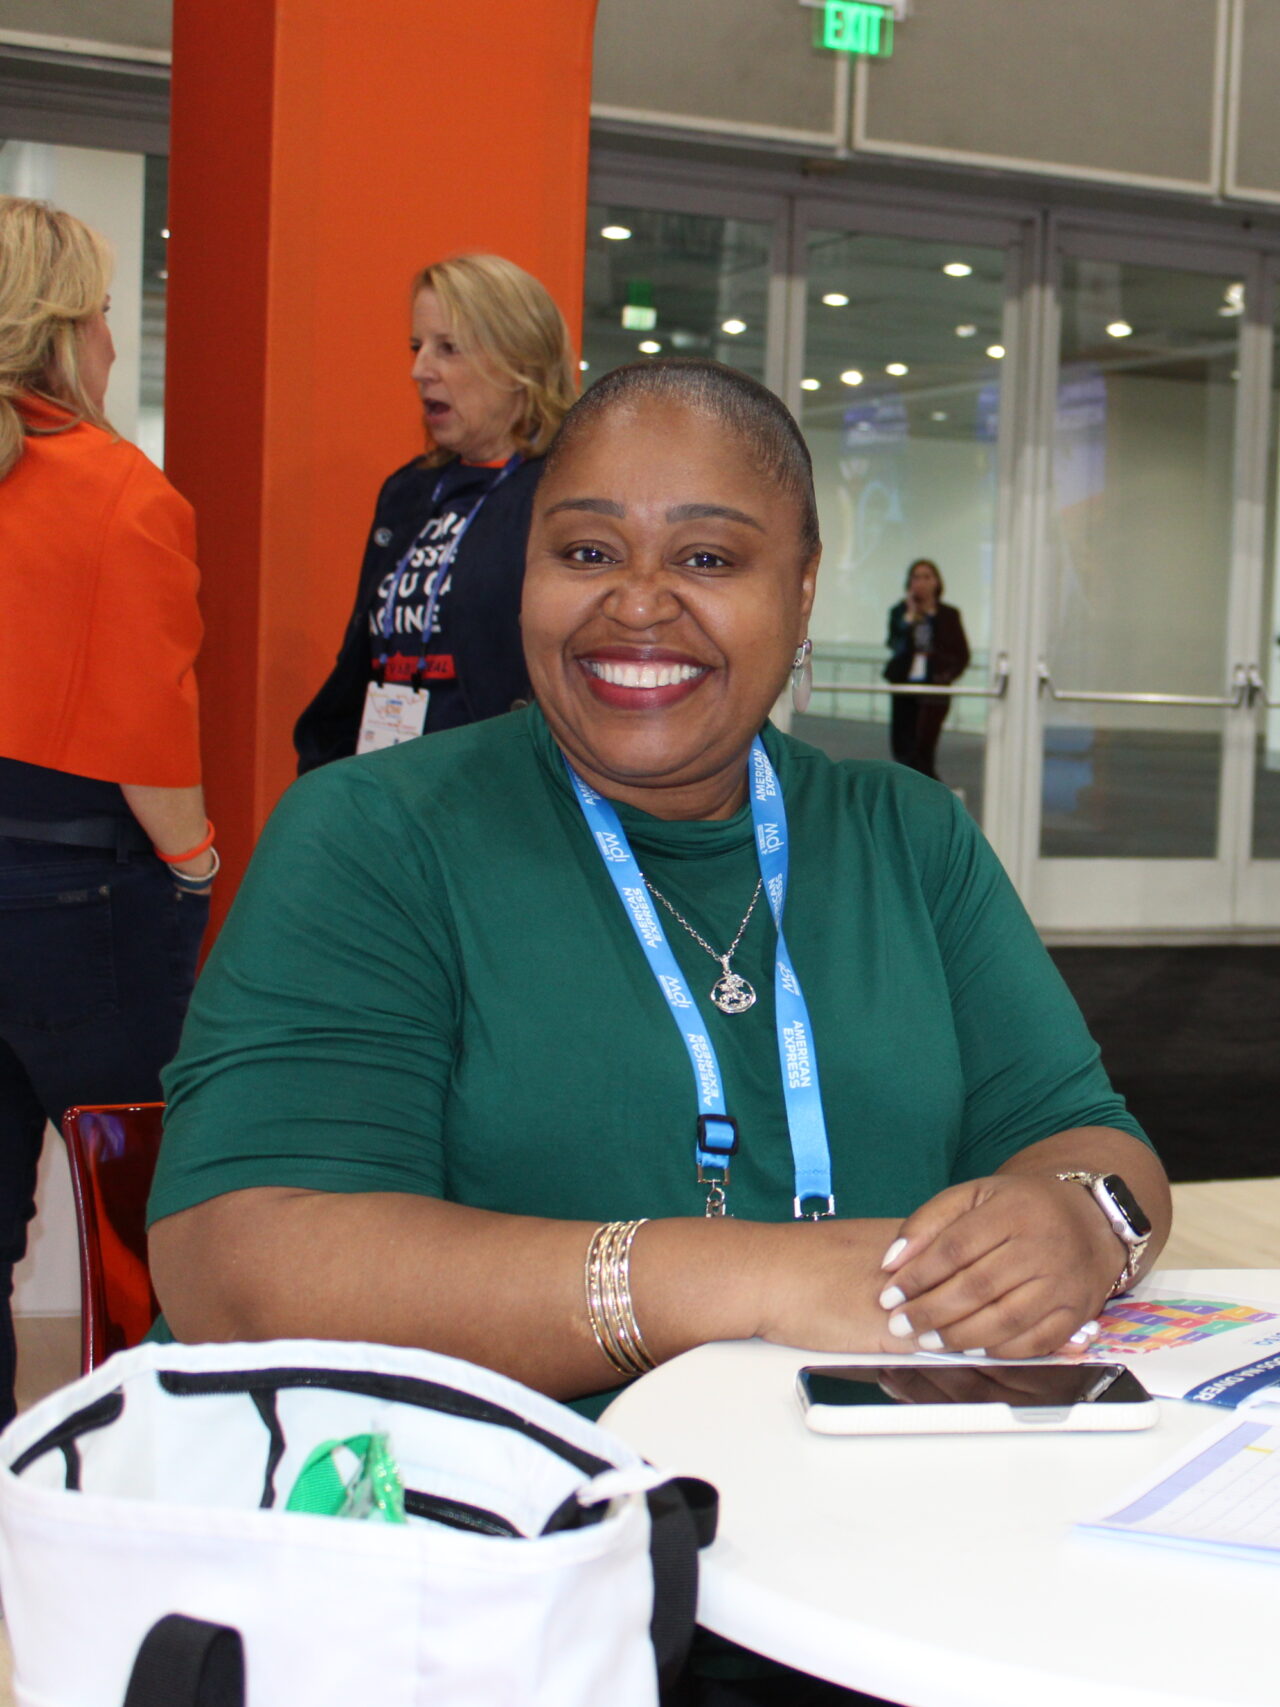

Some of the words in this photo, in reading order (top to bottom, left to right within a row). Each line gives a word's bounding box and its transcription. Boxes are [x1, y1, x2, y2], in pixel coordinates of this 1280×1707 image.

[823, 0, 884, 55] EXIT
[752, 748, 767, 802] AMERICAN
[622, 887, 658, 949] AMERICAN
[632, 887, 663, 943] EXPRESS
[687, 1033, 712, 1107] AMERICAN
[698, 1034, 720, 1099] EXPRESS
[783, 1027, 801, 1089] EXPRESS
[793, 1020, 811, 1088] AMERICAN
